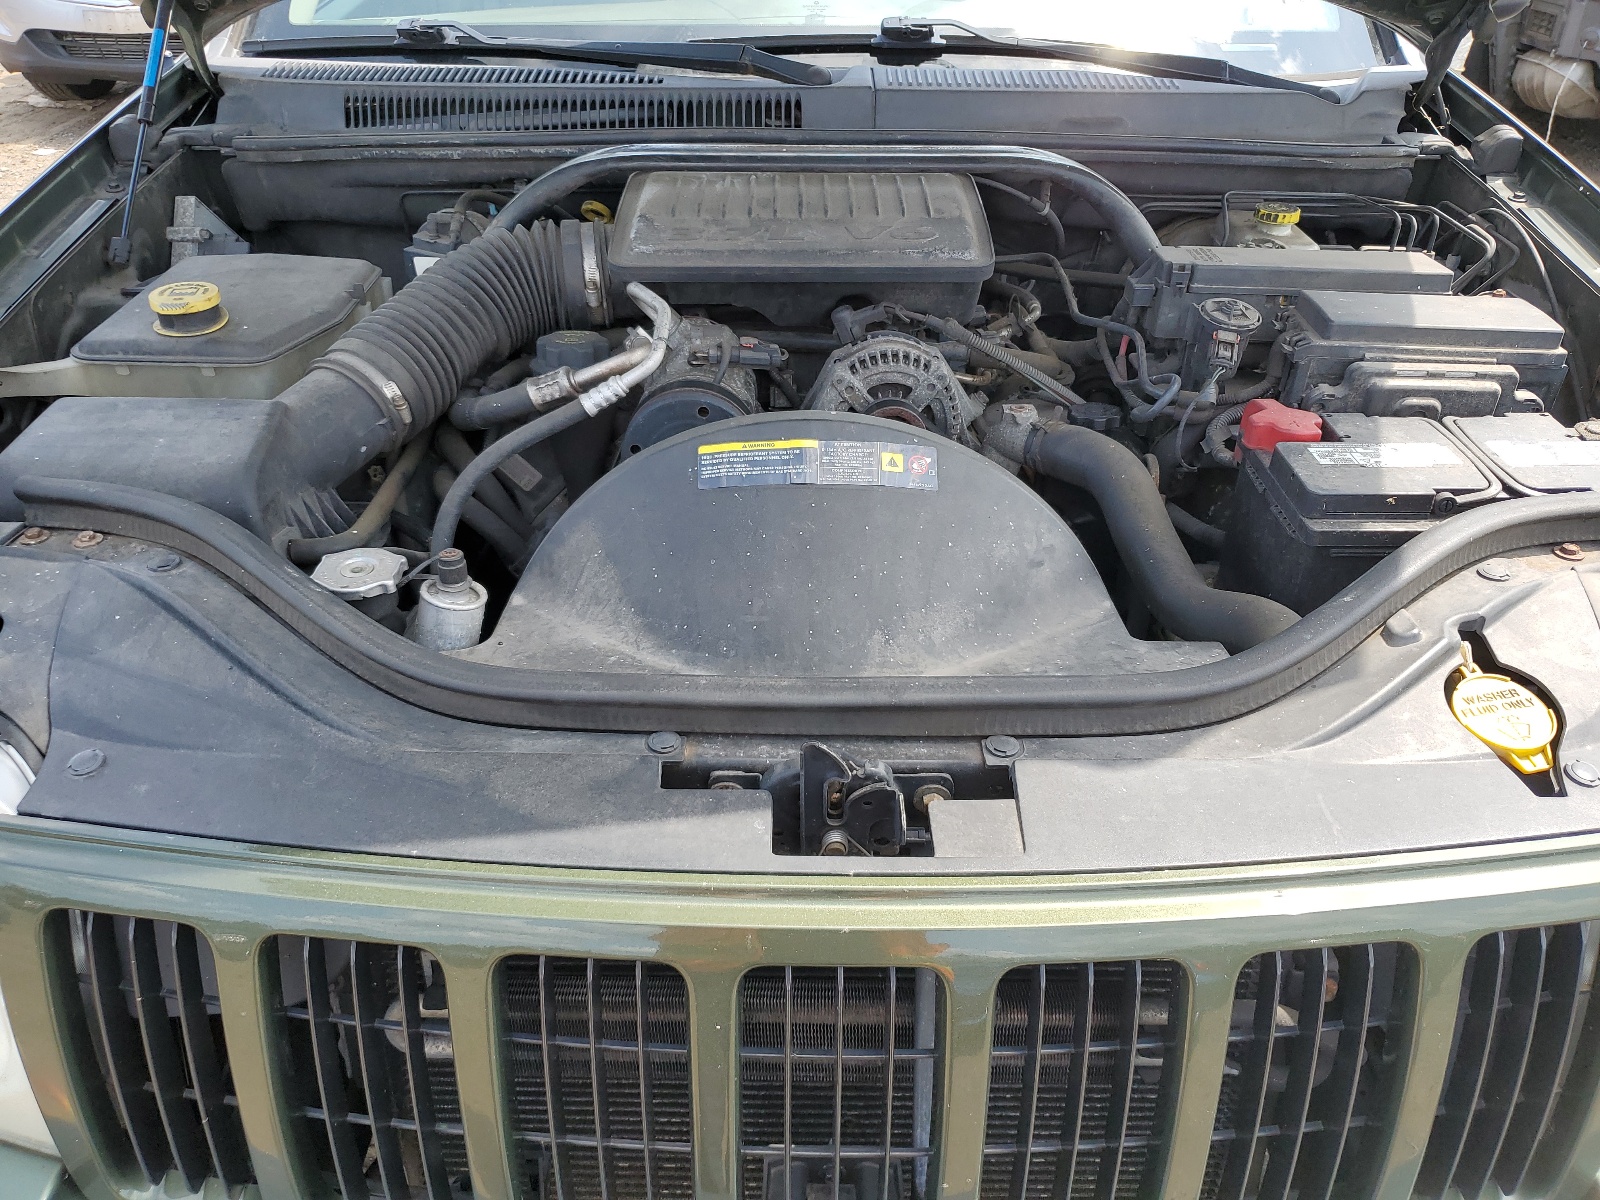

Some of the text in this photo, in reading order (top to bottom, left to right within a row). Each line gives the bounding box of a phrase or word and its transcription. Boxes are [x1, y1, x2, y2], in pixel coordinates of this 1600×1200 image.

[1462, 688, 1520, 705] WASHER
[1461, 697, 1534, 717] FLUID ONLY
